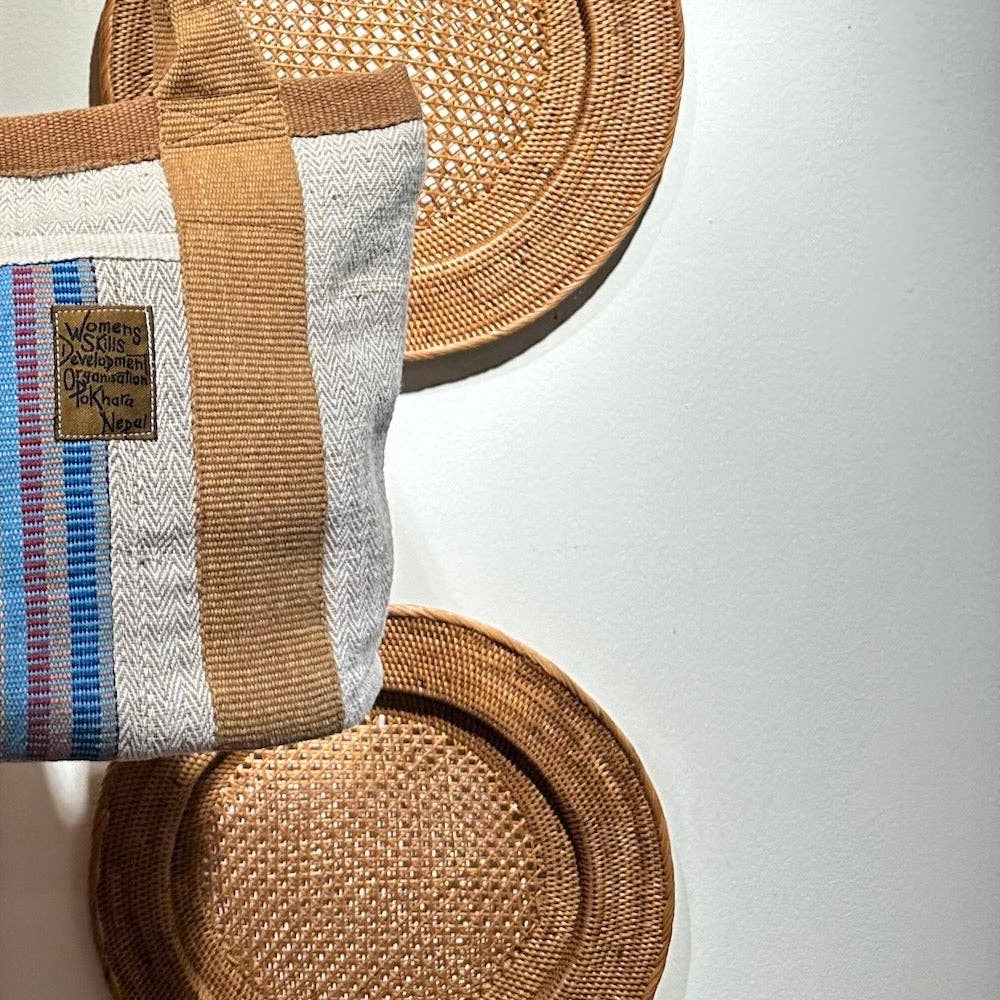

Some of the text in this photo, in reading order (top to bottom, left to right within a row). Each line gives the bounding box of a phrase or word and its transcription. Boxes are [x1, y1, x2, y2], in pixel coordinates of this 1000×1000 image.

[64, 310, 141, 346] Womens
[58, 335, 149, 375] Development
[63, 367, 149, 391] Organisation
[101, 412, 148, 437] Nepal
